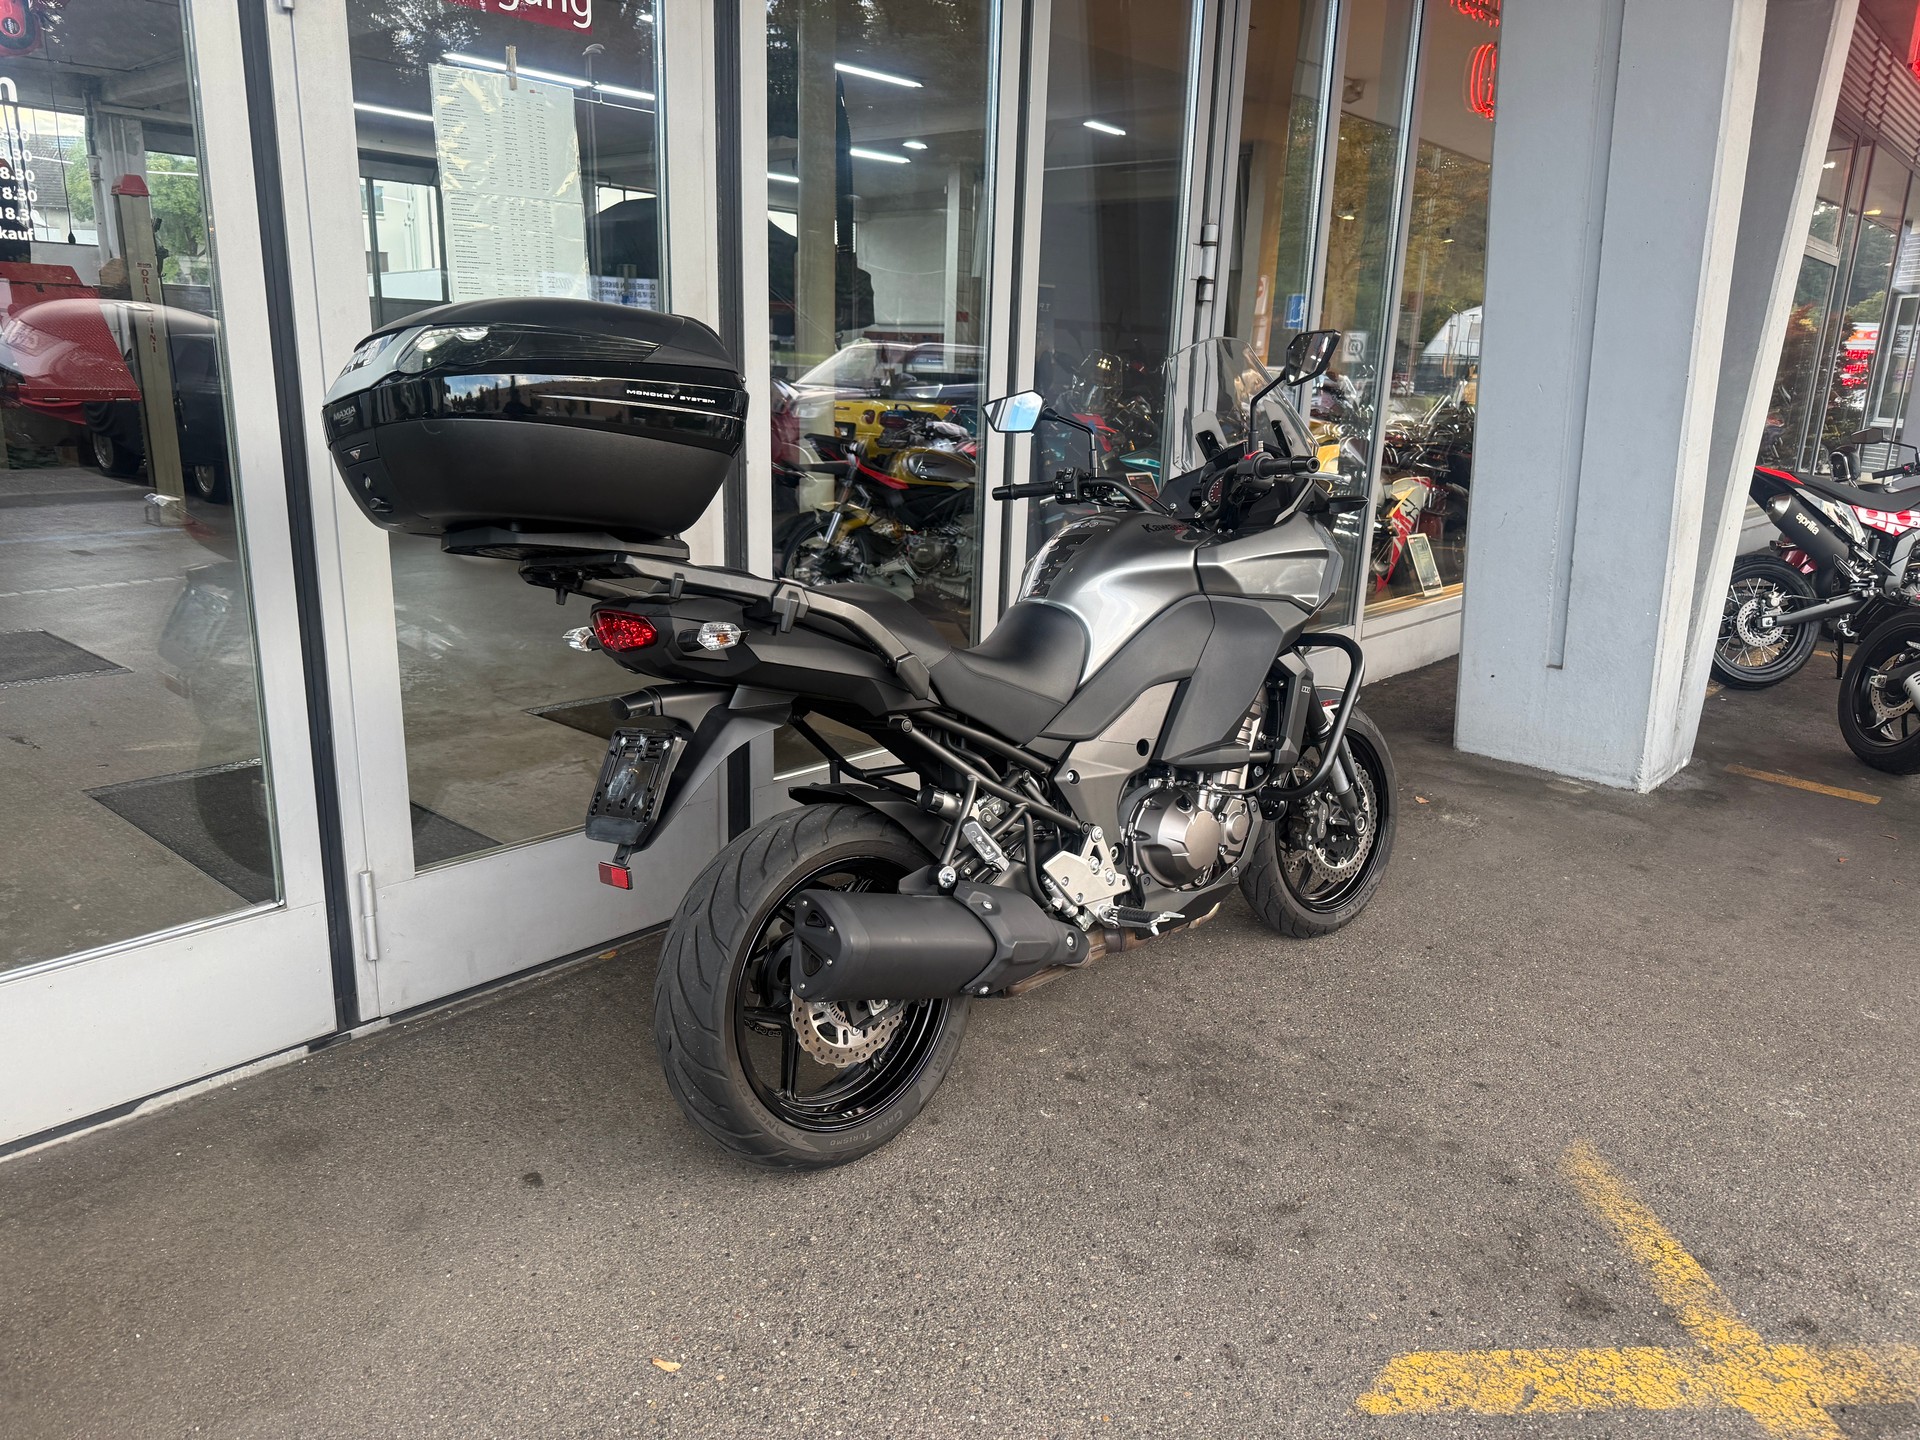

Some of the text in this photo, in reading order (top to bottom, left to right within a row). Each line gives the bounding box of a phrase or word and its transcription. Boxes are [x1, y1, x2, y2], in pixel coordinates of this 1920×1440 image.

[626, 389, 716, 404] MONOKEY SYSTEM
[333, 406, 356, 421] MAXIA
[1795, 512, 1820, 535] aprilia
[829, 1109, 904, 1147] GRAN TURISMO
